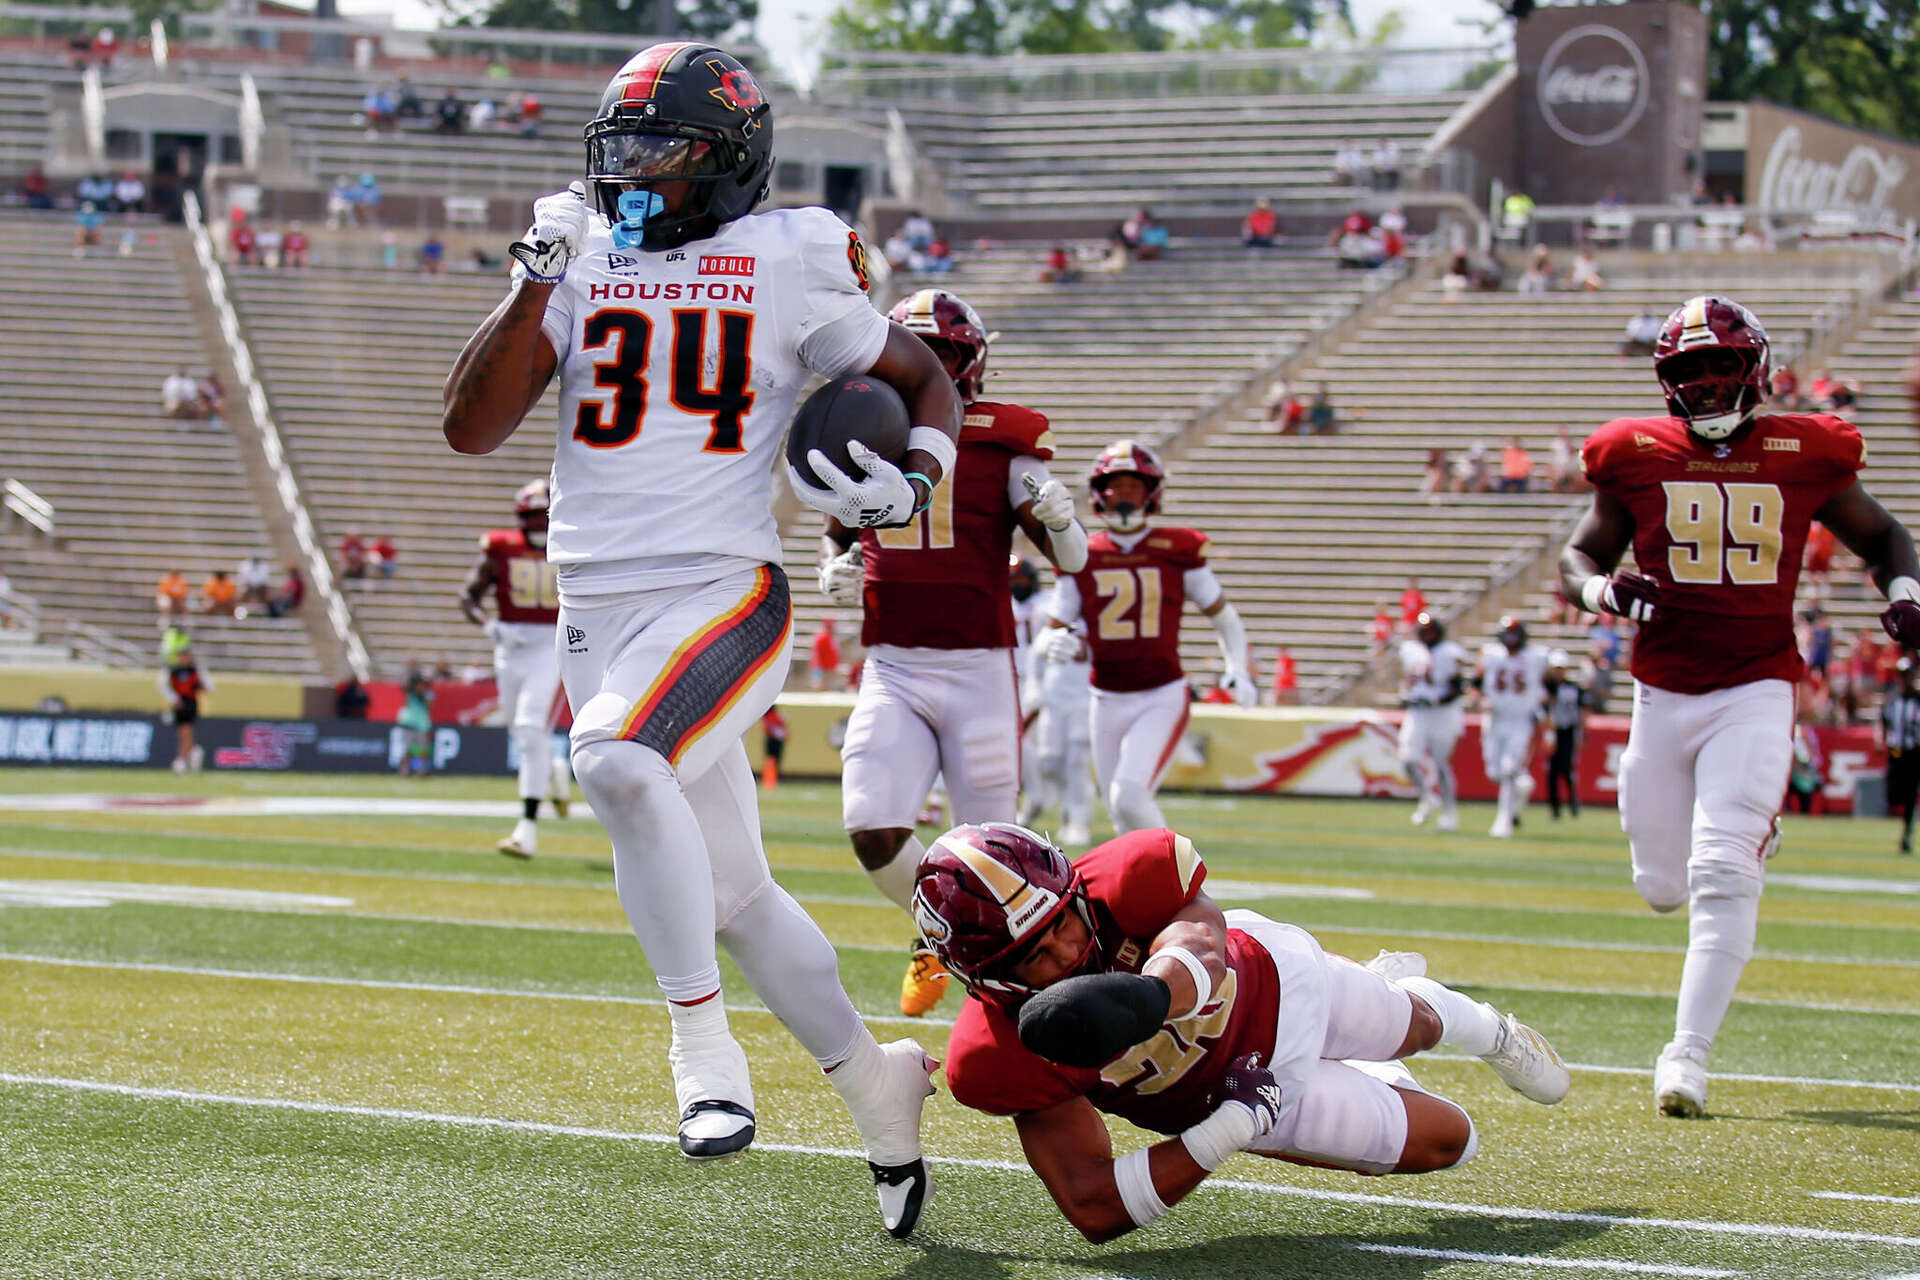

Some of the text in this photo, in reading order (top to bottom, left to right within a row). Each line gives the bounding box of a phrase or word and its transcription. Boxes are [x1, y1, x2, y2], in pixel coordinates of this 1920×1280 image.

[666, 250, 687, 262] UFL
[699, 257, 754, 275] NOBULL
[590, 283, 755, 304] HOUSTON
[573, 307, 757, 454] 34
[1661, 481, 1784, 584] 99
[1092, 567, 1162, 640] 21
